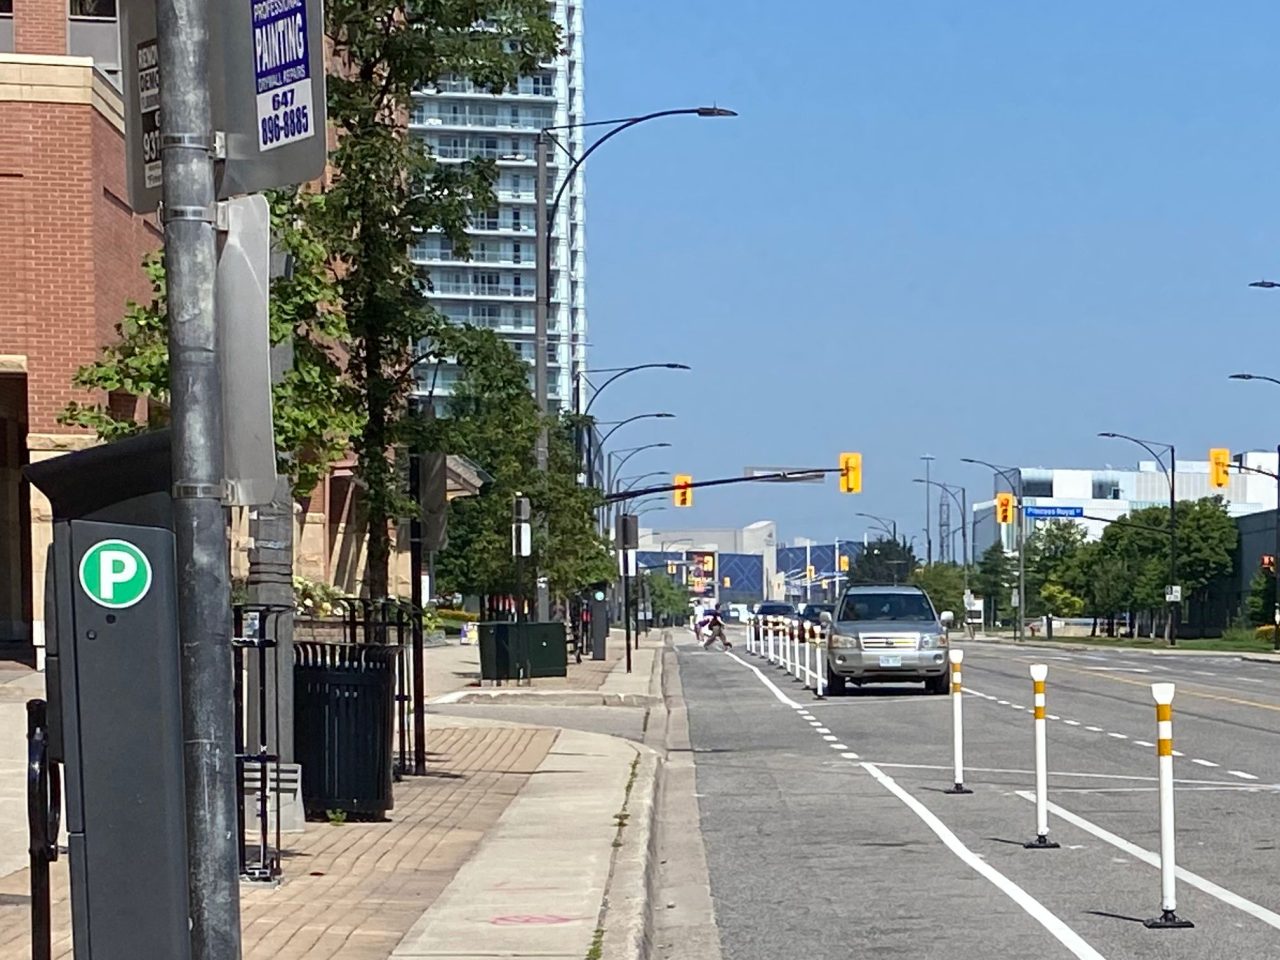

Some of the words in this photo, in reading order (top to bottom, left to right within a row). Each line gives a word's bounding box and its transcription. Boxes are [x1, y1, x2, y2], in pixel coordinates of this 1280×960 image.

[255, 12, 304, 73] PAINTING
[272, 89, 295, 111] 647
[261, 105, 309, 145] 896-8885
[1057, 508, 1075, 516] Royal
[100, 551, 138, 600] P
